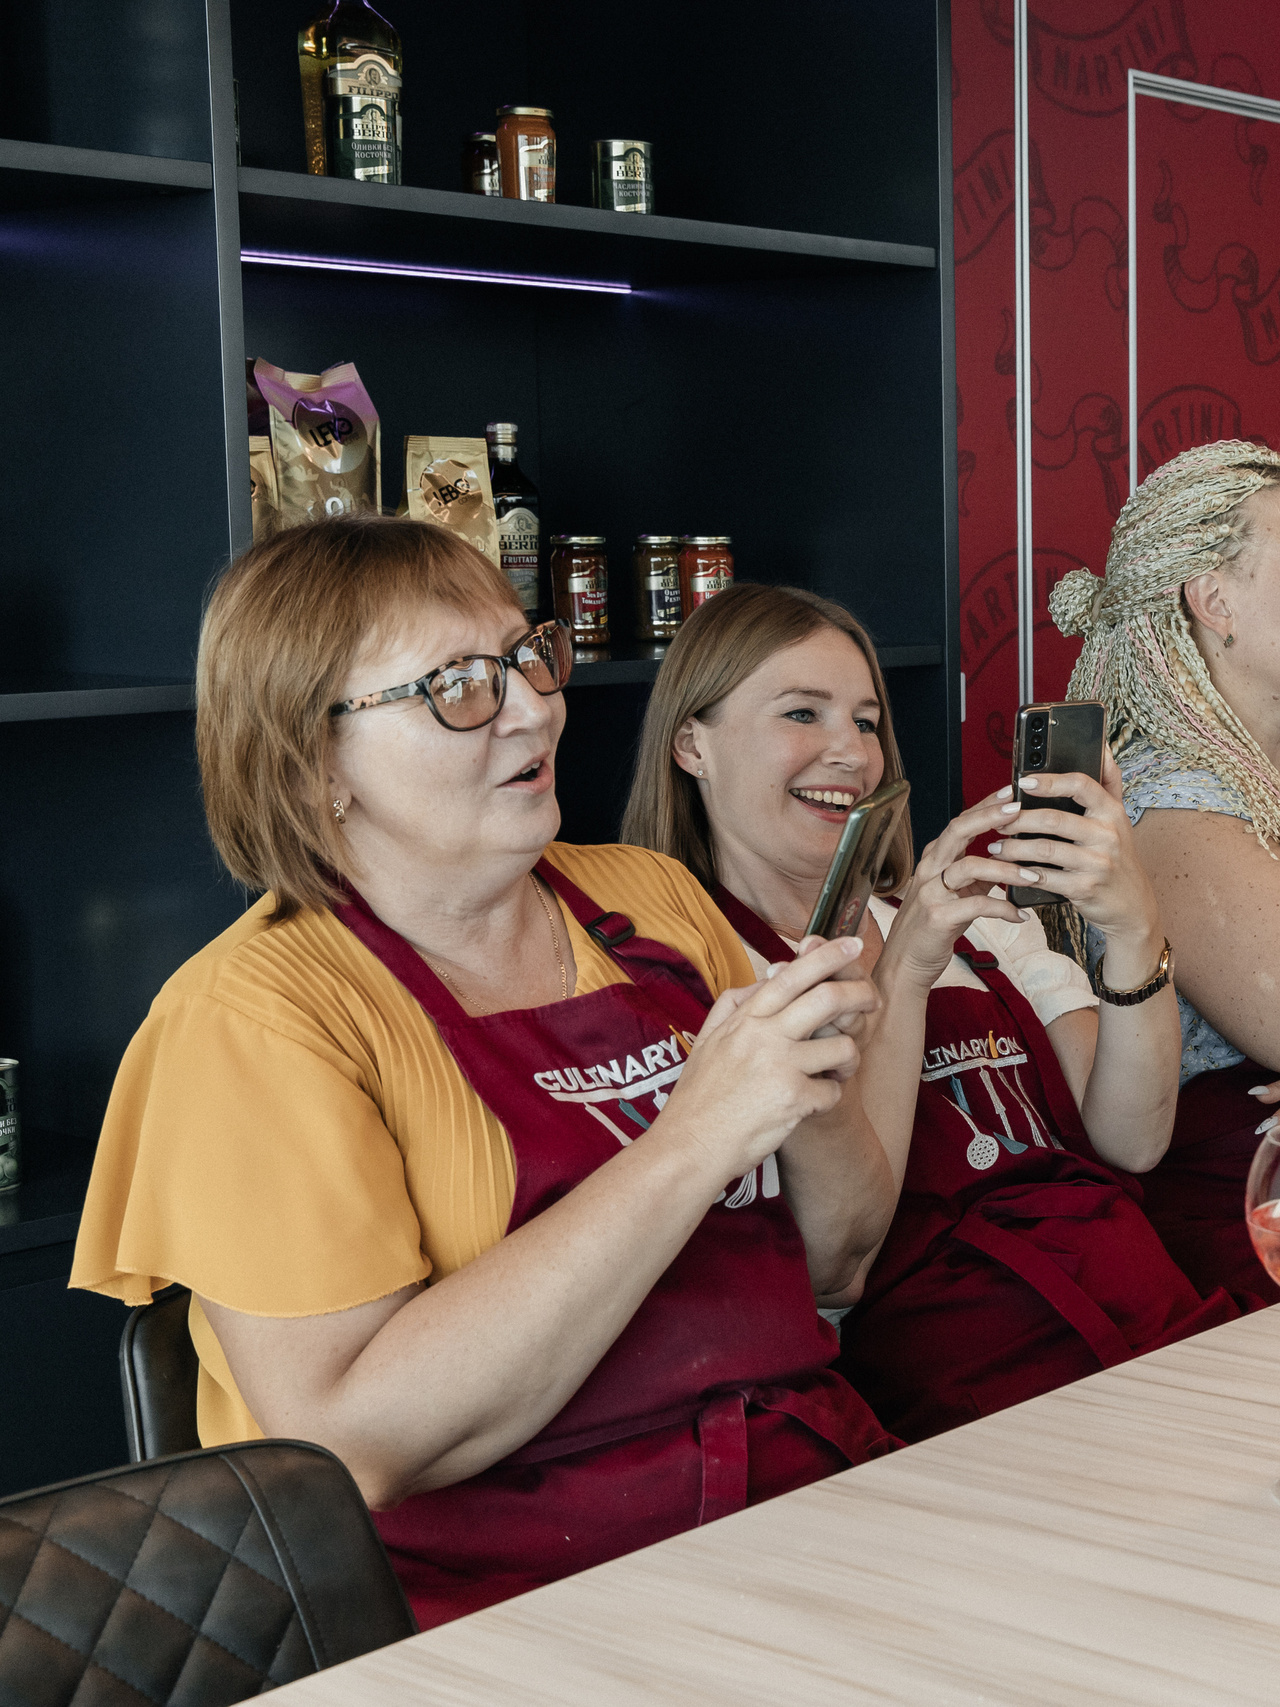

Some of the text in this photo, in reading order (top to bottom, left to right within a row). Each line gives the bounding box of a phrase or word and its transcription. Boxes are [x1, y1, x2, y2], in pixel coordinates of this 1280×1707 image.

[1053, 5, 1166, 97] MARTINI
[1122, 403, 1225, 476] ARTINI
[503, 556, 538, 564] FRUTTATO
